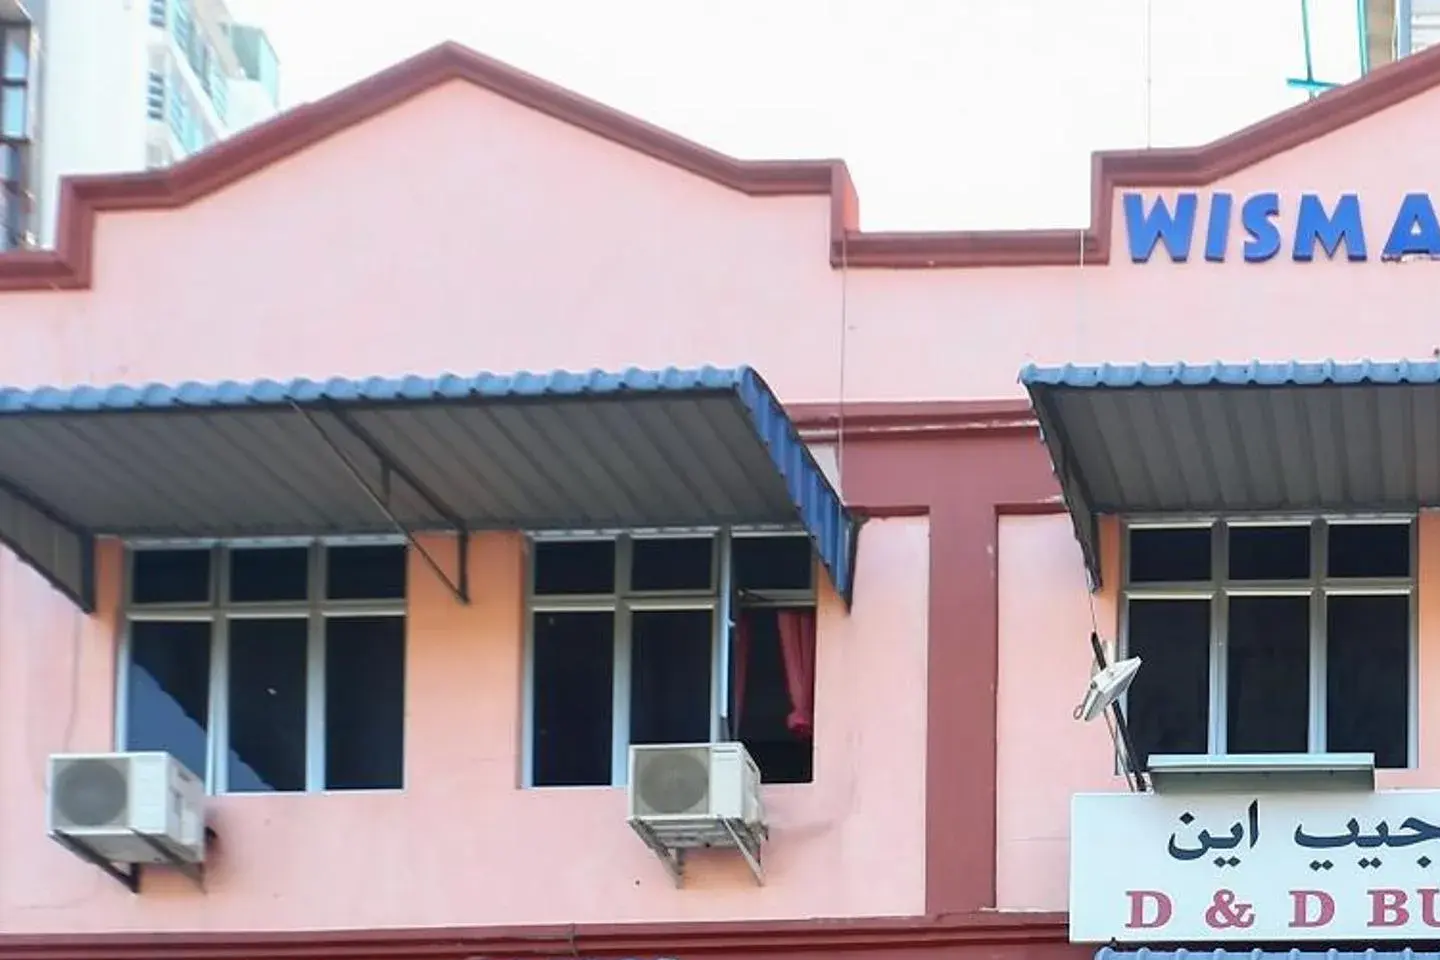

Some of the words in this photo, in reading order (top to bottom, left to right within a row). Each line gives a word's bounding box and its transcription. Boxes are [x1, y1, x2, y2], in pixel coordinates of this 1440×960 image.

[1125, 889, 1173, 928] D
[1205, 888, 1256, 928] &
[1288, 889, 1336, 928] D
